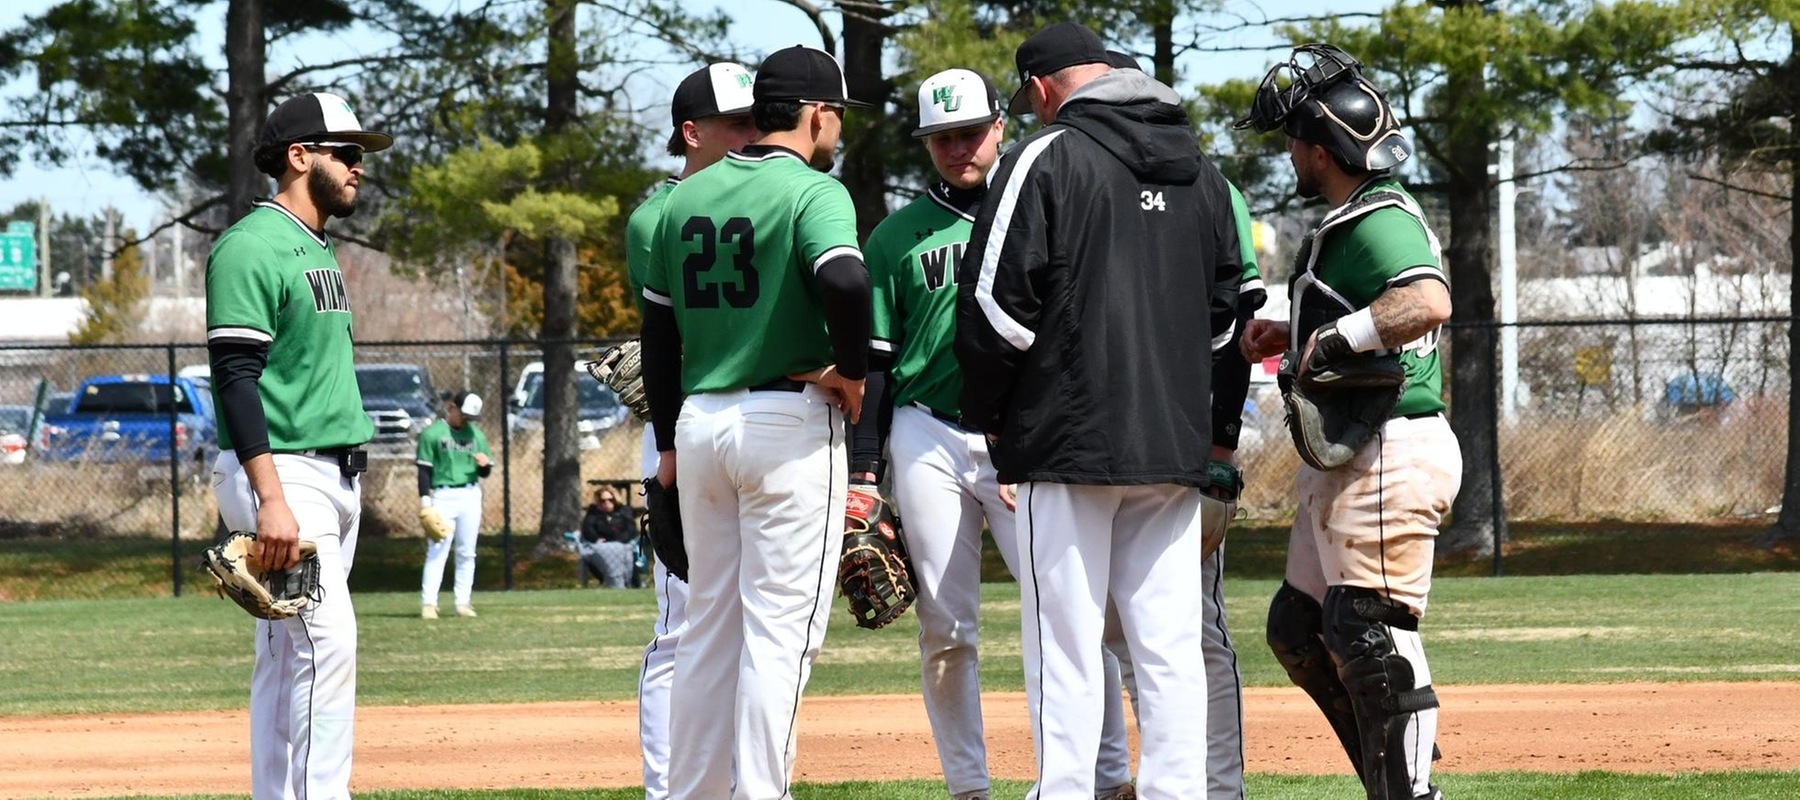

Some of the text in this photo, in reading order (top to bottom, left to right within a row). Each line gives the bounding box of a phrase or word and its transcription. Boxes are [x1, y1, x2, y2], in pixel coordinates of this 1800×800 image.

[1140, 190, 1166, 211] 34
[681, 216, 760, 308] 23
[303, 268, 351, 313] WILM
